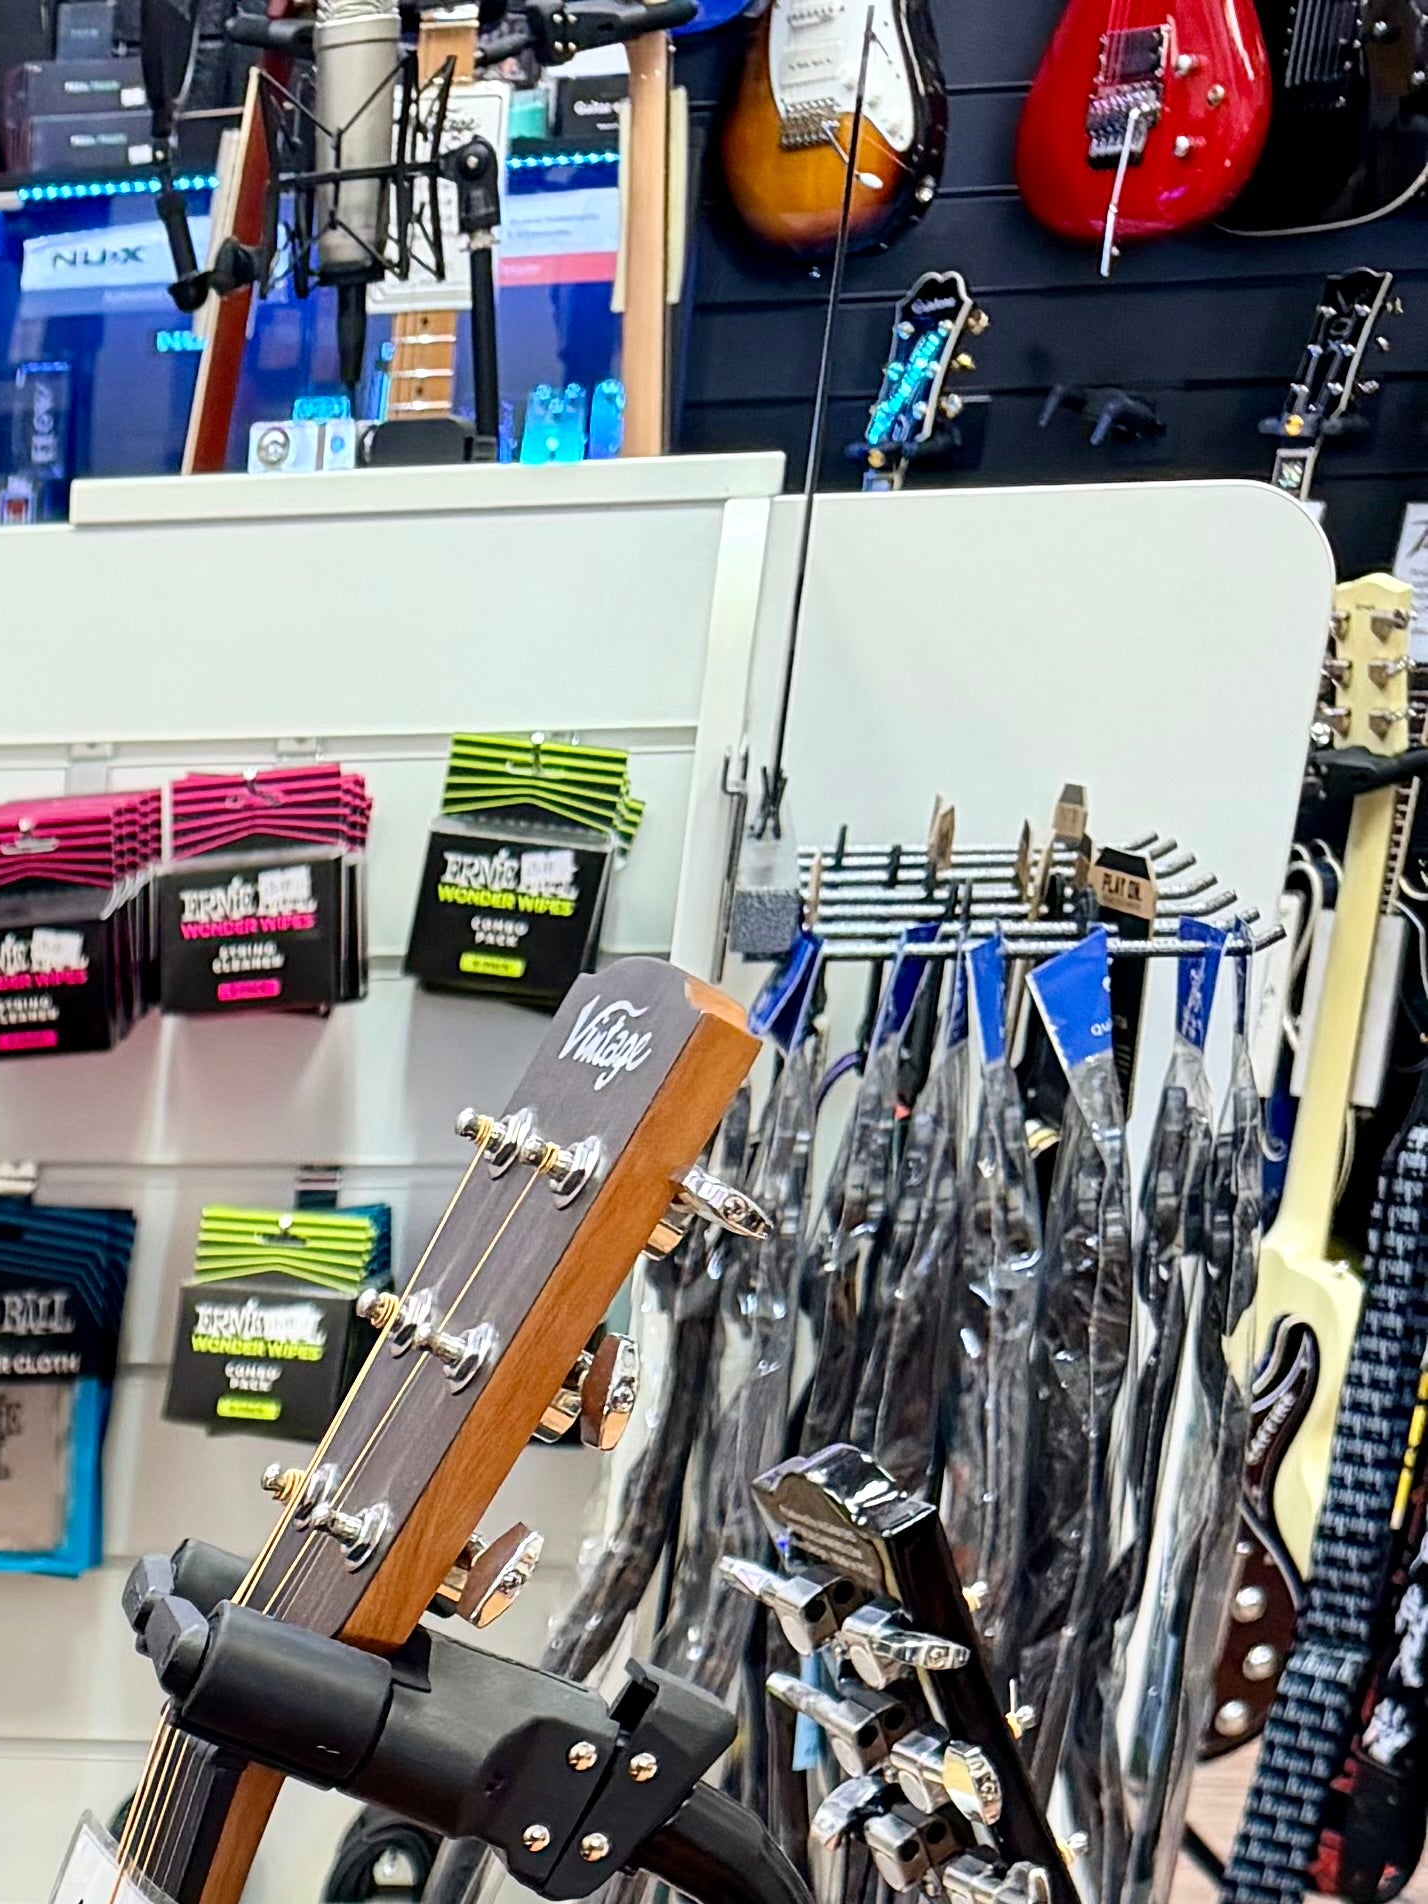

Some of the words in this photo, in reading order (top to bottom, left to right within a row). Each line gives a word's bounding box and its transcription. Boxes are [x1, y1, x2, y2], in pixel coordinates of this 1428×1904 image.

[441, 847, 520, 891] ERNIE
[179, 874, 257, 923] ERNIE
[438, 883, 517, 910] WONDER
[518, 894, 575, 917] WIPES
[181, 917, 258, 940] WONDER
[260, 914, 316, 932] WIPES
[558, 993, 653, 1091] Vintage
[0, 1292, 76, 1336] BALL
[12, 1353, 82, 1375] CLOTH
[192, 1333, 265, 1357] WONDER
[267, 1341, 324, 1362] WIPES
